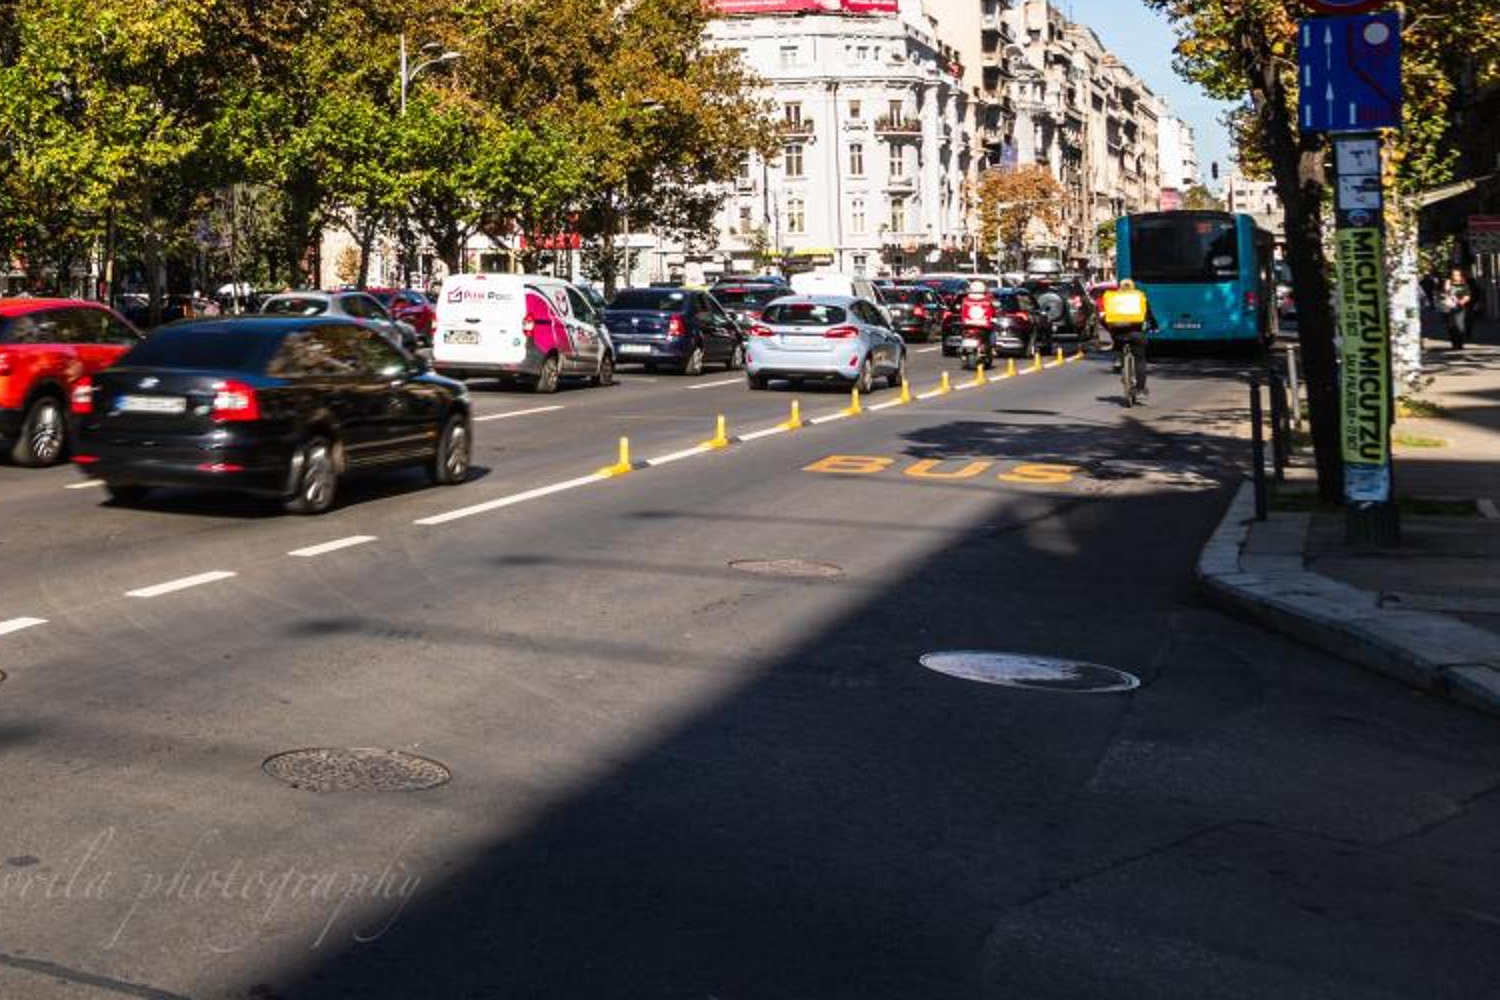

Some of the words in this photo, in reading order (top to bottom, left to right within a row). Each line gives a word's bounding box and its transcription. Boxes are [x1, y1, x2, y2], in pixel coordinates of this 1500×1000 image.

[1352, 231, 1382, 343] MICUTZU
[1359, 347, 1382, 460] MICUTZU
[800, 454, 1082, 484] BUS
